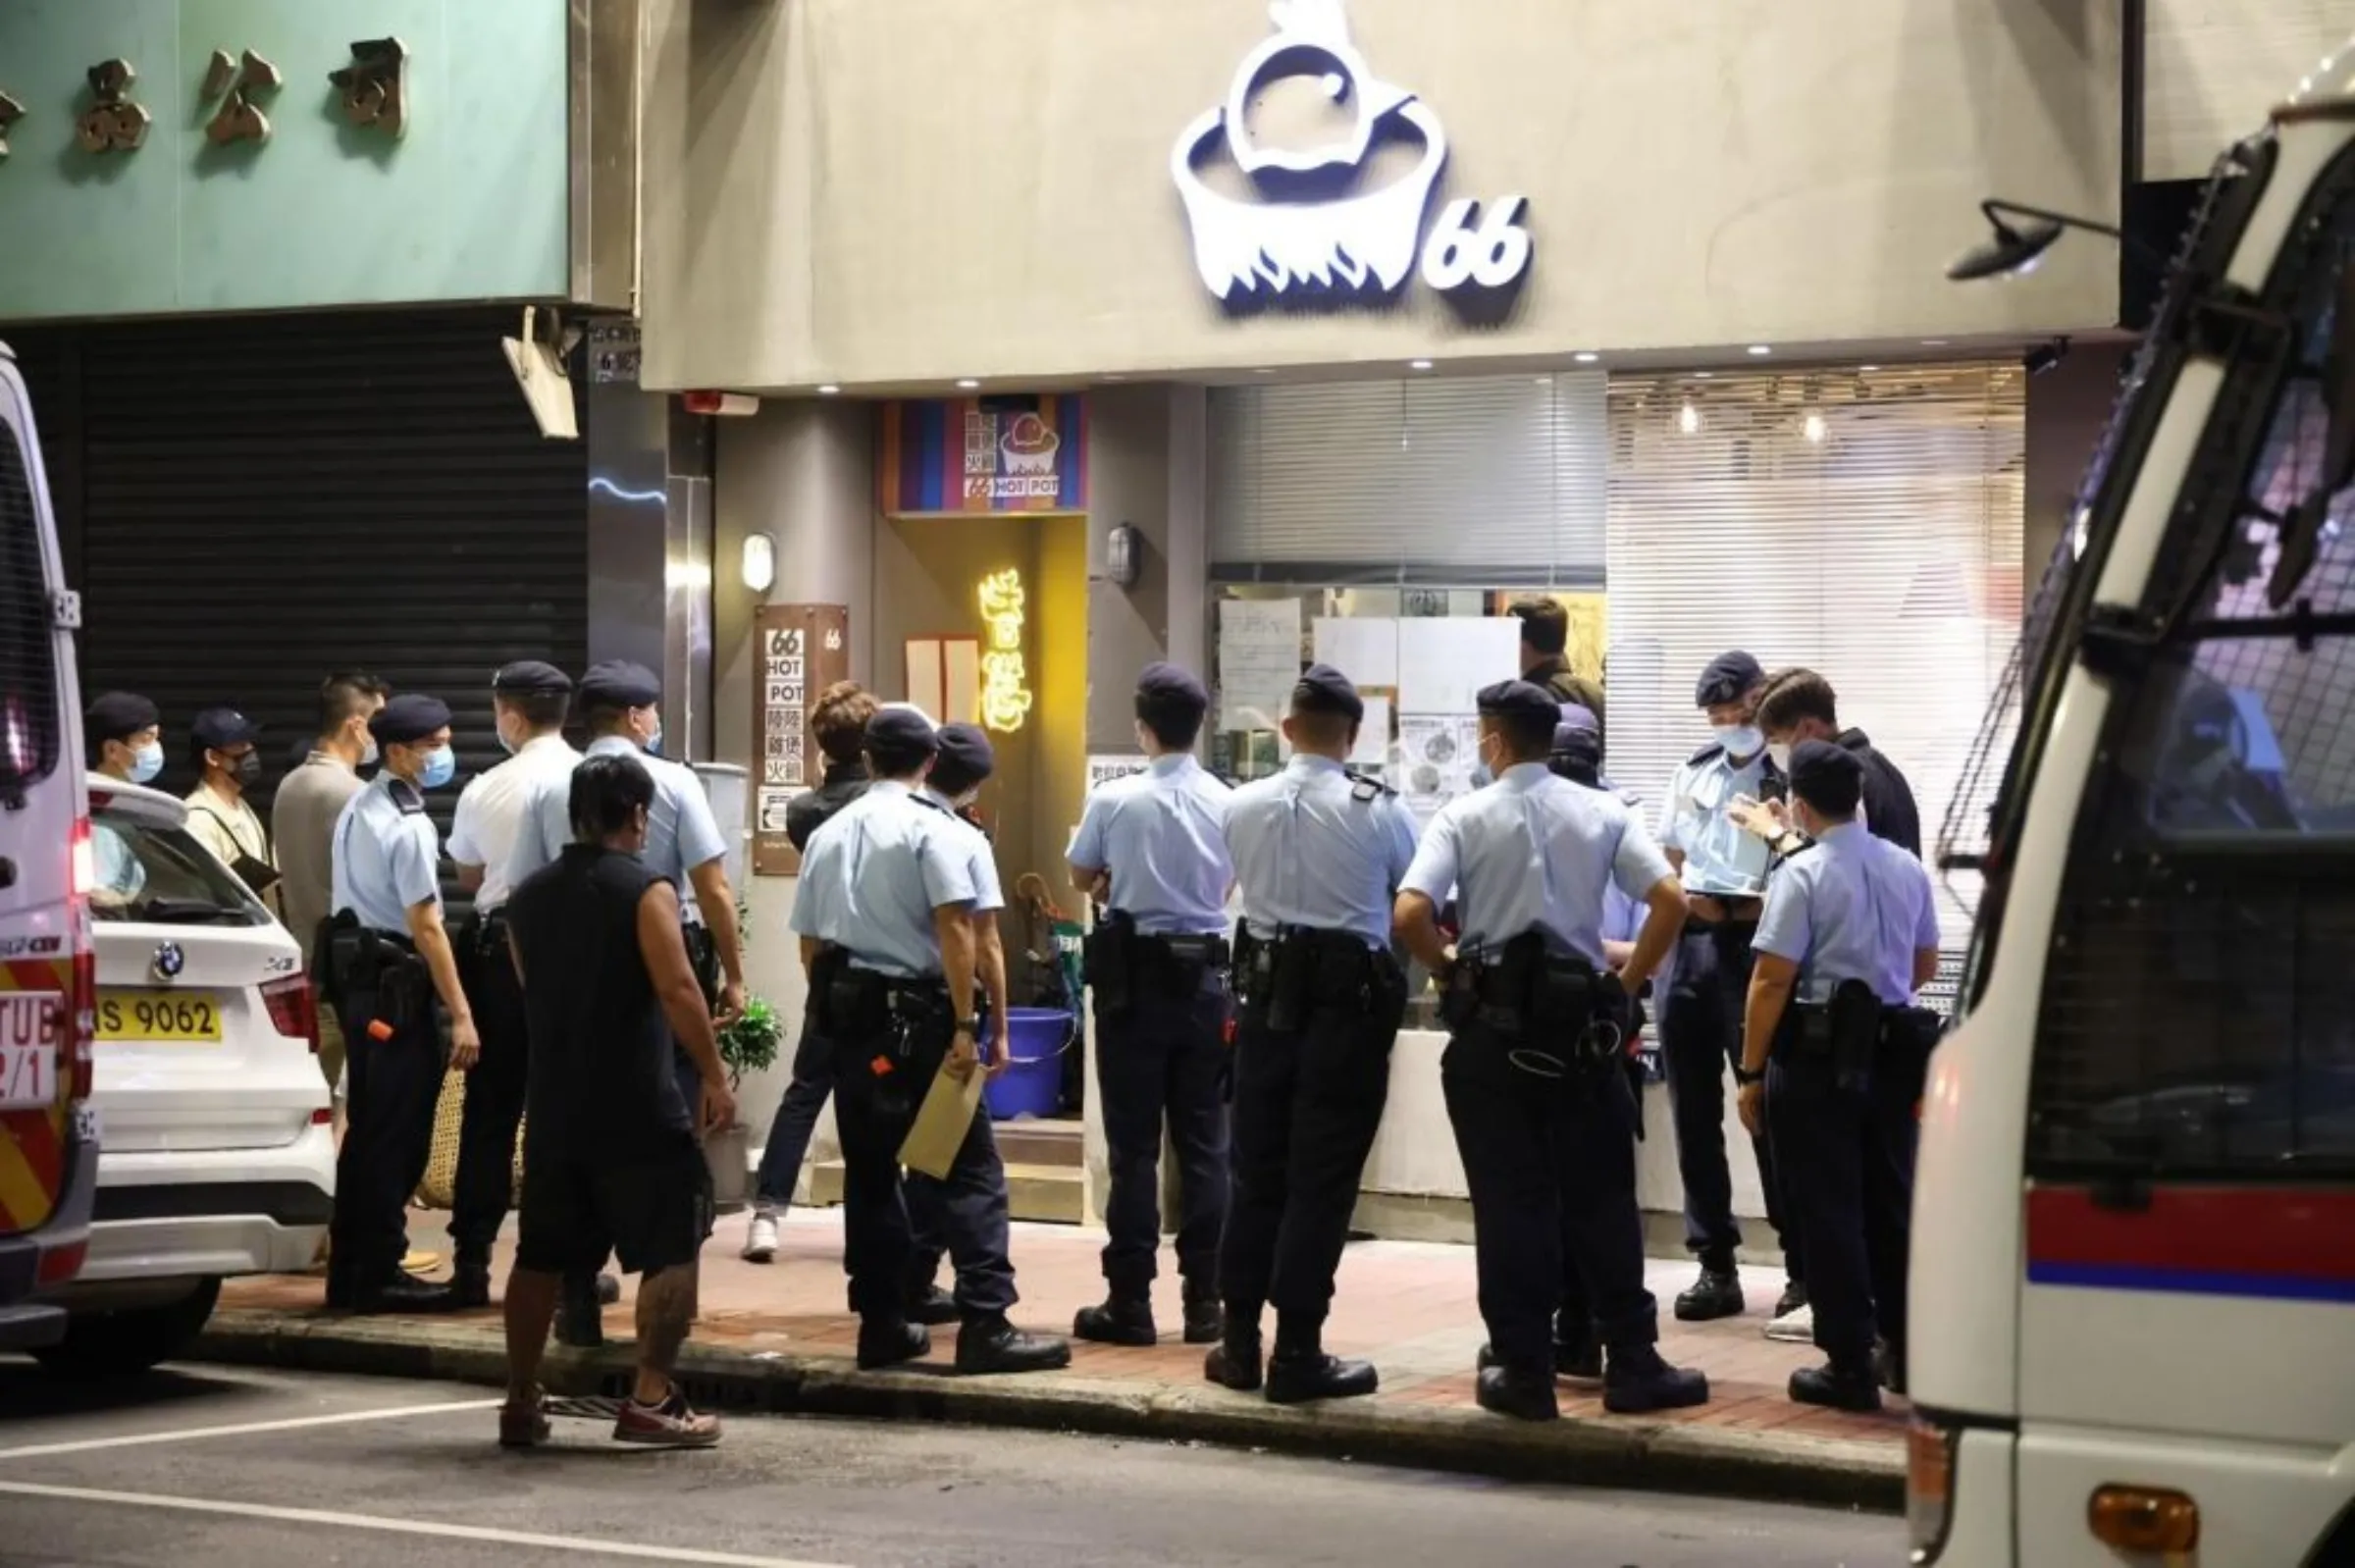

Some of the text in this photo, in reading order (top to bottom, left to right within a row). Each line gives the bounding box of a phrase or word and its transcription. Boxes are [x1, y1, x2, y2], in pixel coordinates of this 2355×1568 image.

[1423, 196, 1530, 291] 66
[996, 479, 1024, 494] HOT
[1031, 480, 1058, 493] POT
[770, 629, 800, 656] 66
[824, 628, 842, 650] 66
[765, 660, 801, 675] HOT
[771, 685, 804, 701] POT
[134, 999, 214, 1034] 9062
